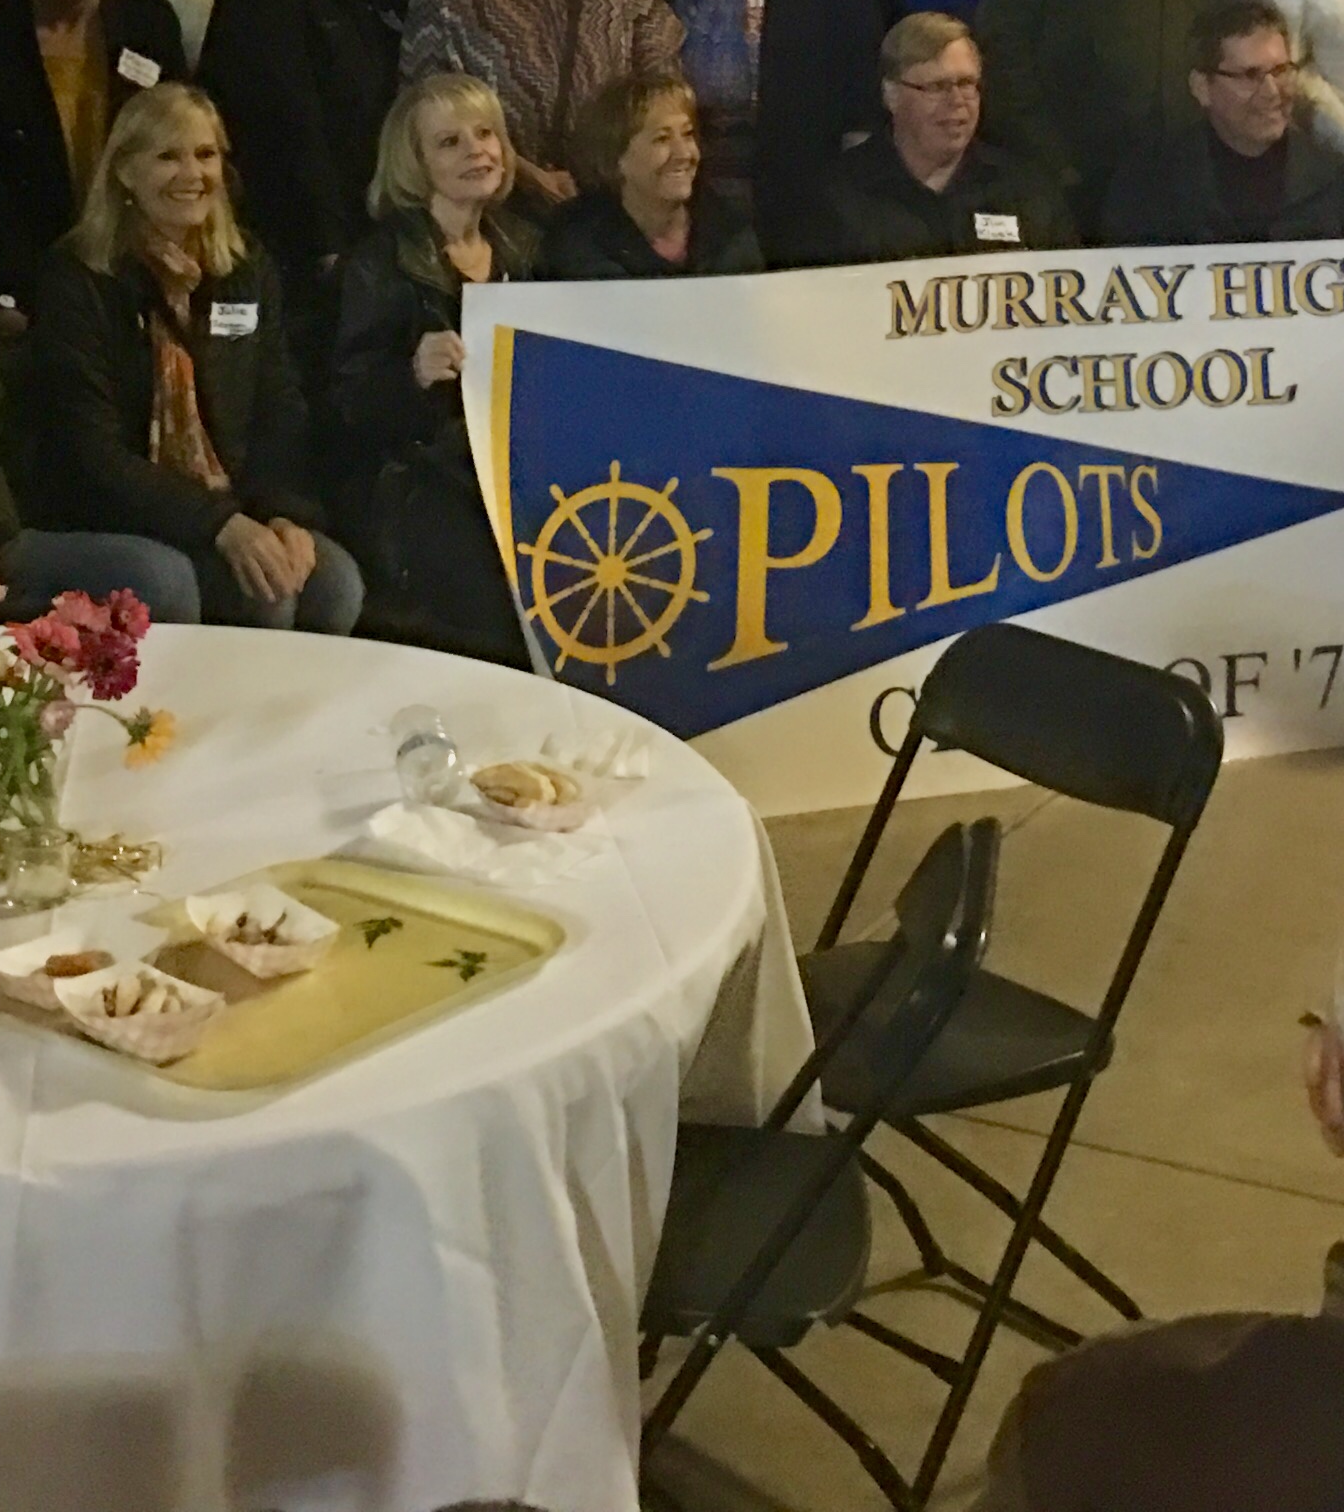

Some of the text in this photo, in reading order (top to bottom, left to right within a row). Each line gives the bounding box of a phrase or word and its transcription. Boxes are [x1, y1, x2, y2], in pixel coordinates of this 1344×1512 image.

[885, 264, 1195, 340] MURRAY
[991, 347, 1298, 417] SCHOOL
[706, 461, 1163, 672] PILOTS
